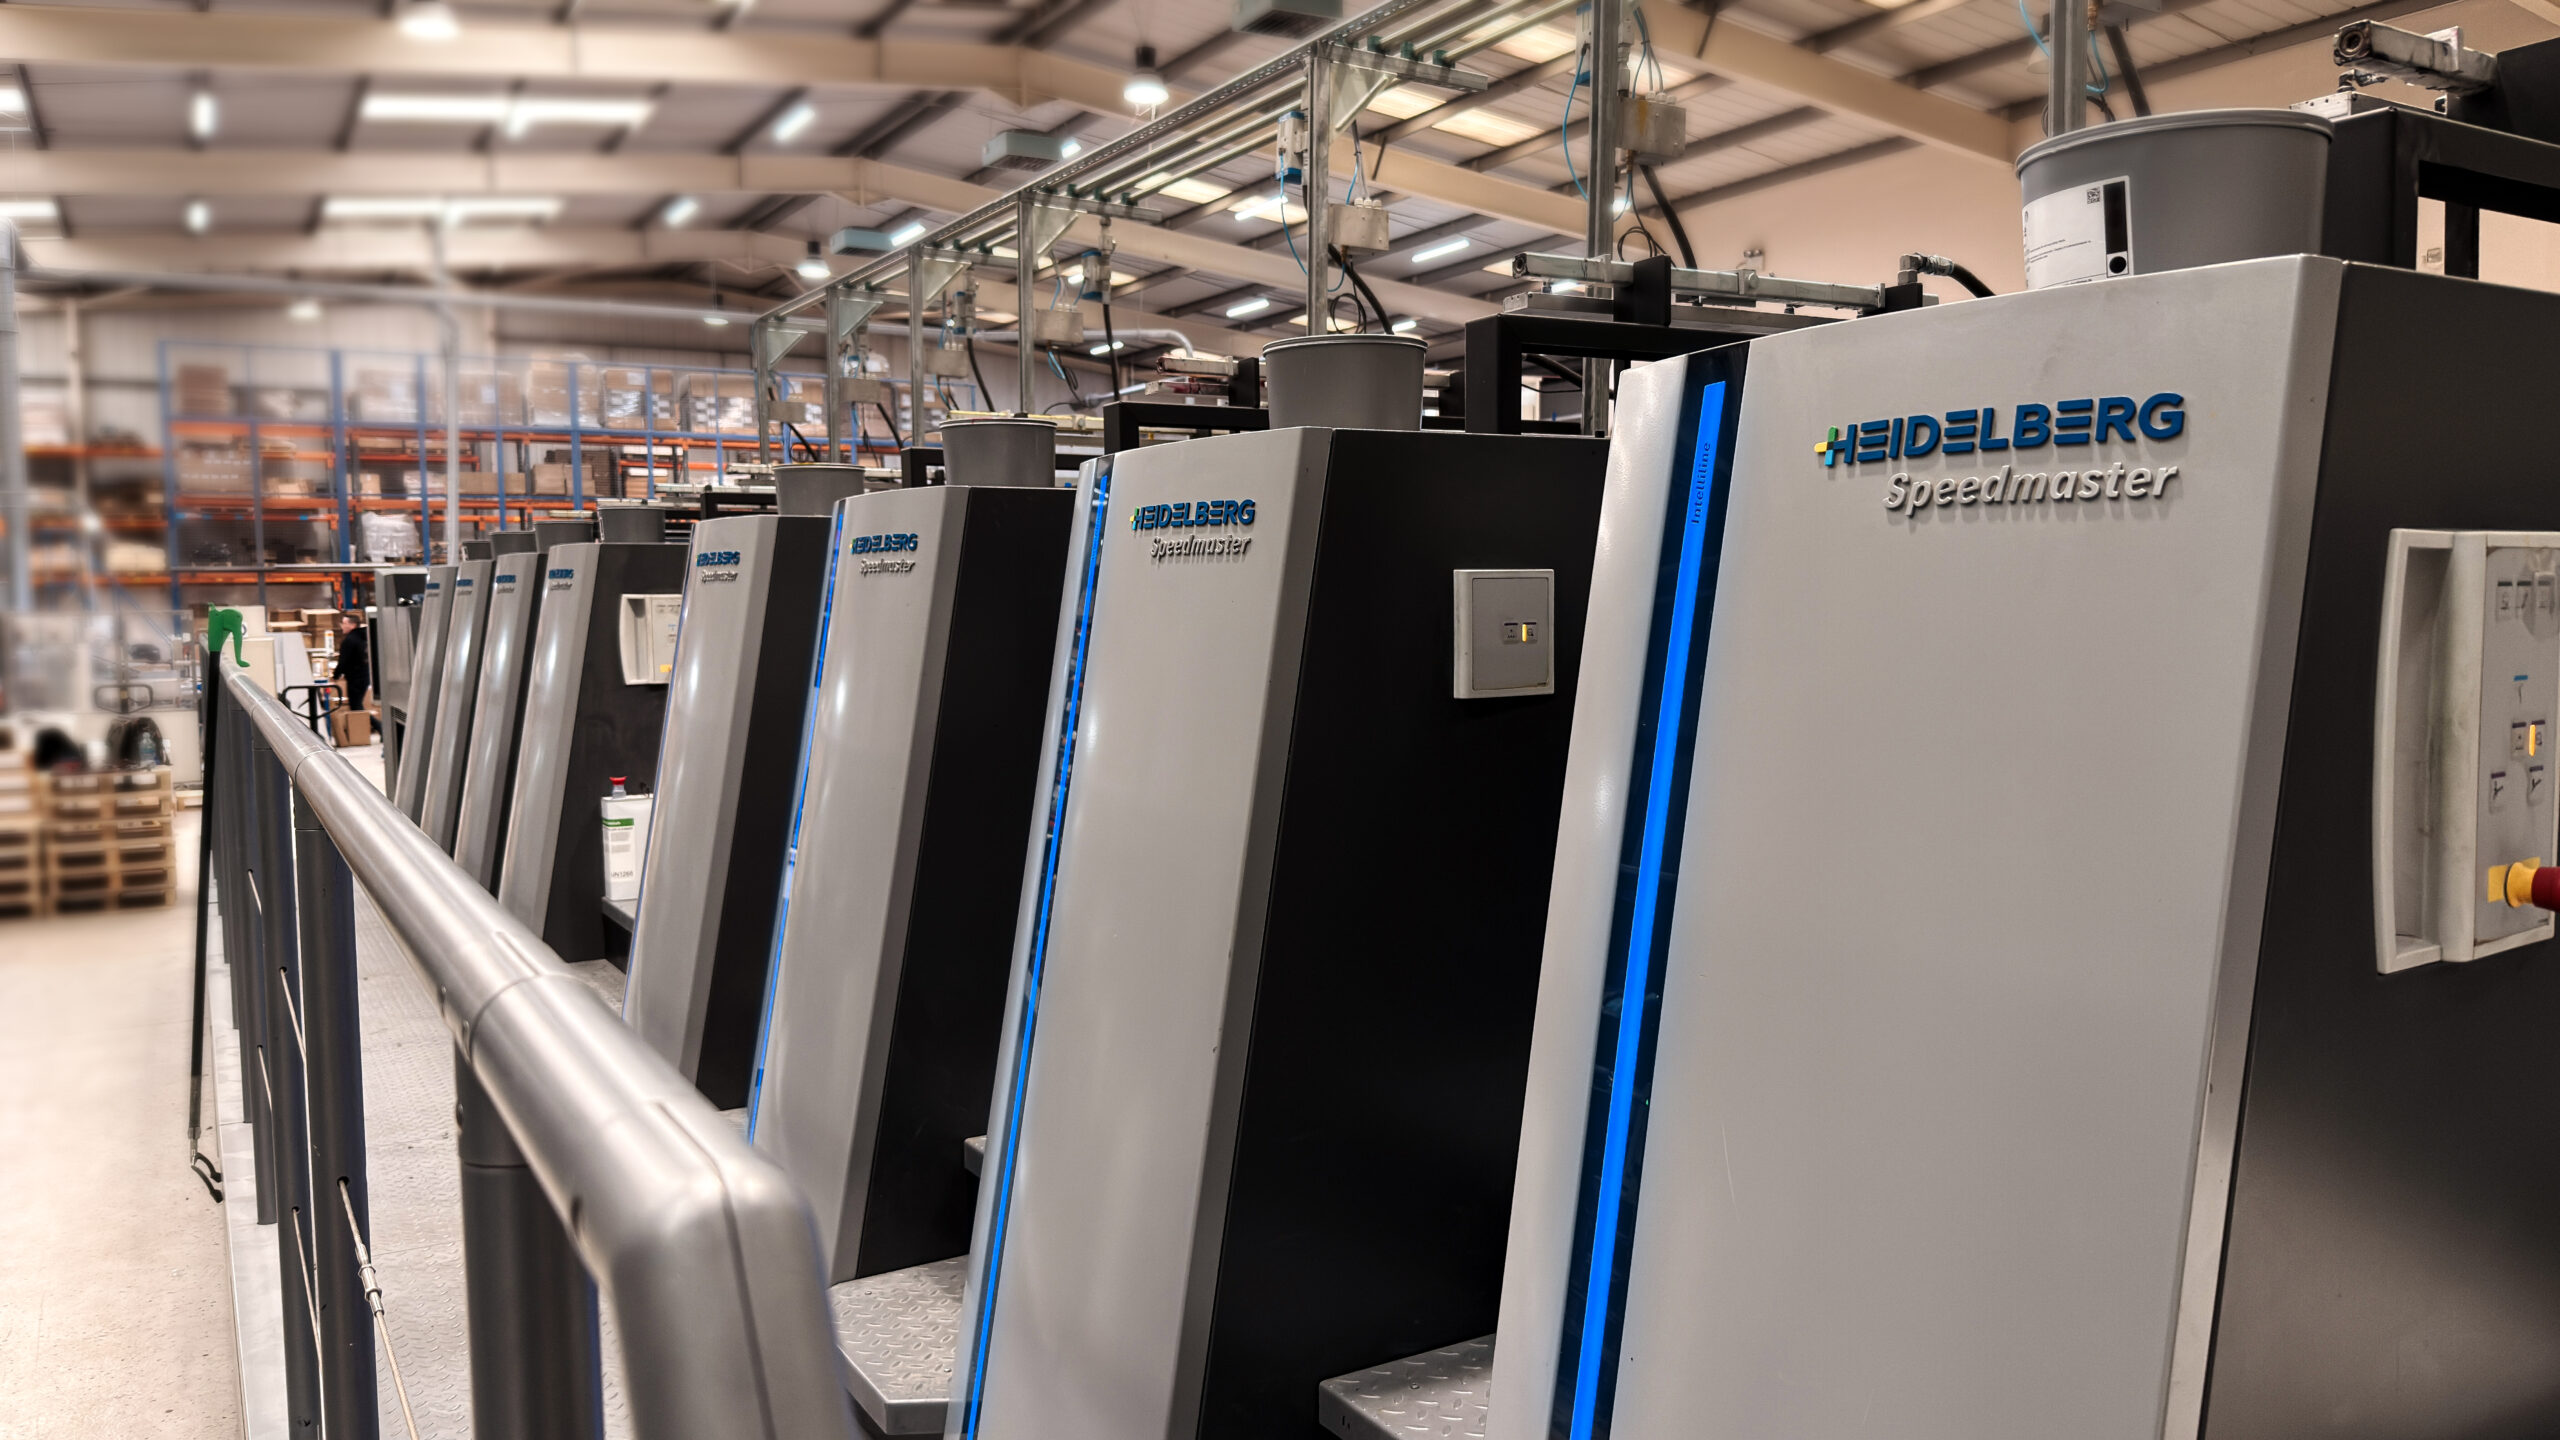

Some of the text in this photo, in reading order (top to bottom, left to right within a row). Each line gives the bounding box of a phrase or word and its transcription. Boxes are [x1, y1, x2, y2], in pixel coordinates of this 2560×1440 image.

[1814, 392, 2185, 467] HEIDELBERG
[1691, 442, 1711, 524] Intelliline
[1883, 462, 2179, 516] Speedmaster
[1130, 499, 1256, 530] HEIDELBERG
[1151, 534, 1251, 560] Speedmaster
